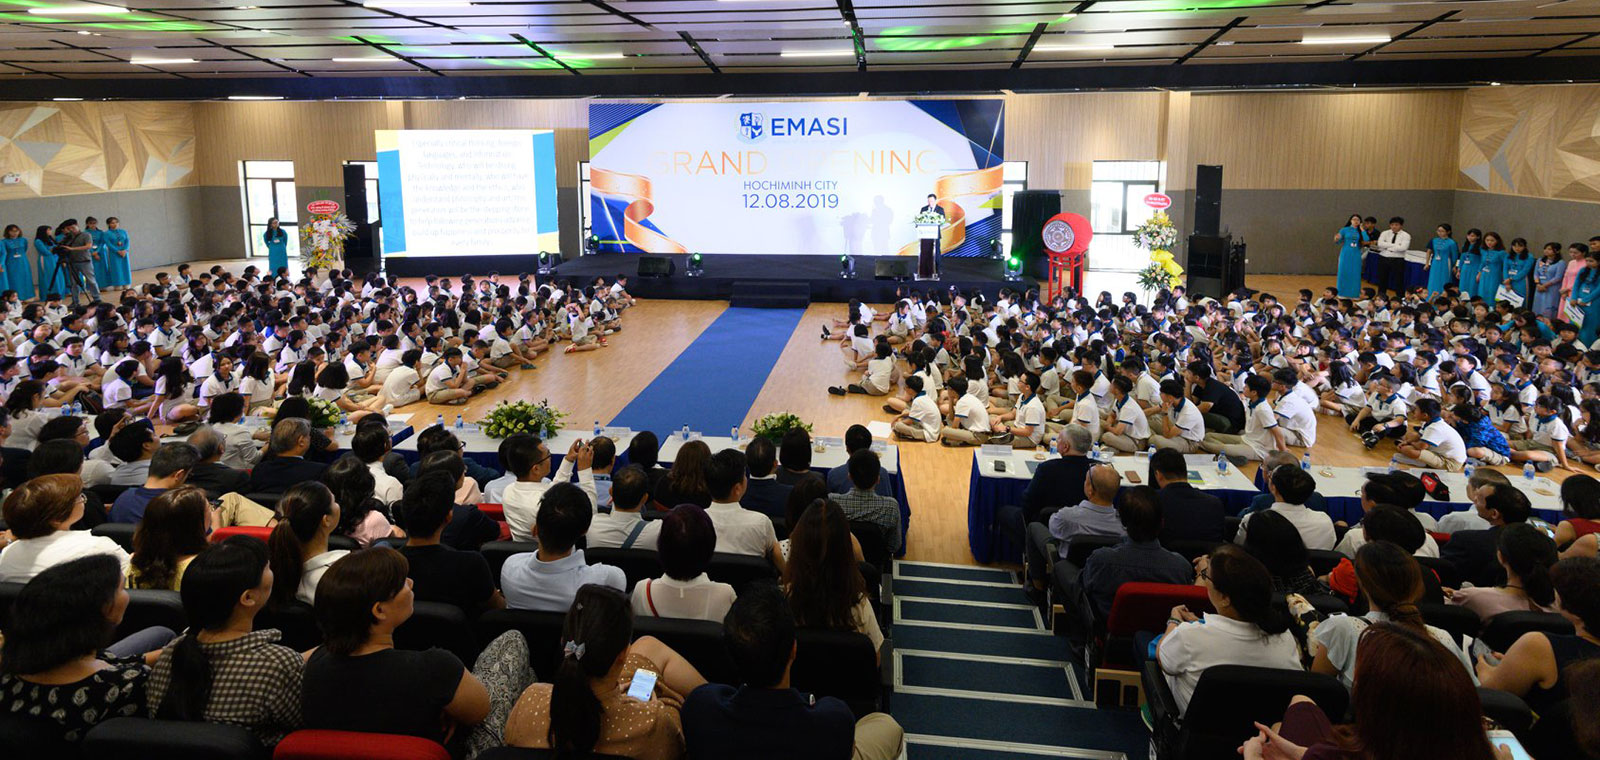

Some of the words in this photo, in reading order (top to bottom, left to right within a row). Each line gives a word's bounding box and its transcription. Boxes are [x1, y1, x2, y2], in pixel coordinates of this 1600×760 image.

[771, 117, 848, 136] EMASI
[655, 150, 768, 175] GRAND
[780, 149, 937, 175] PENING
[743, 181, 812, 191] HOCHIMINH
[815, 181, 839, 190] CITY
[742, 193, 839, 209] 12.08.2019
